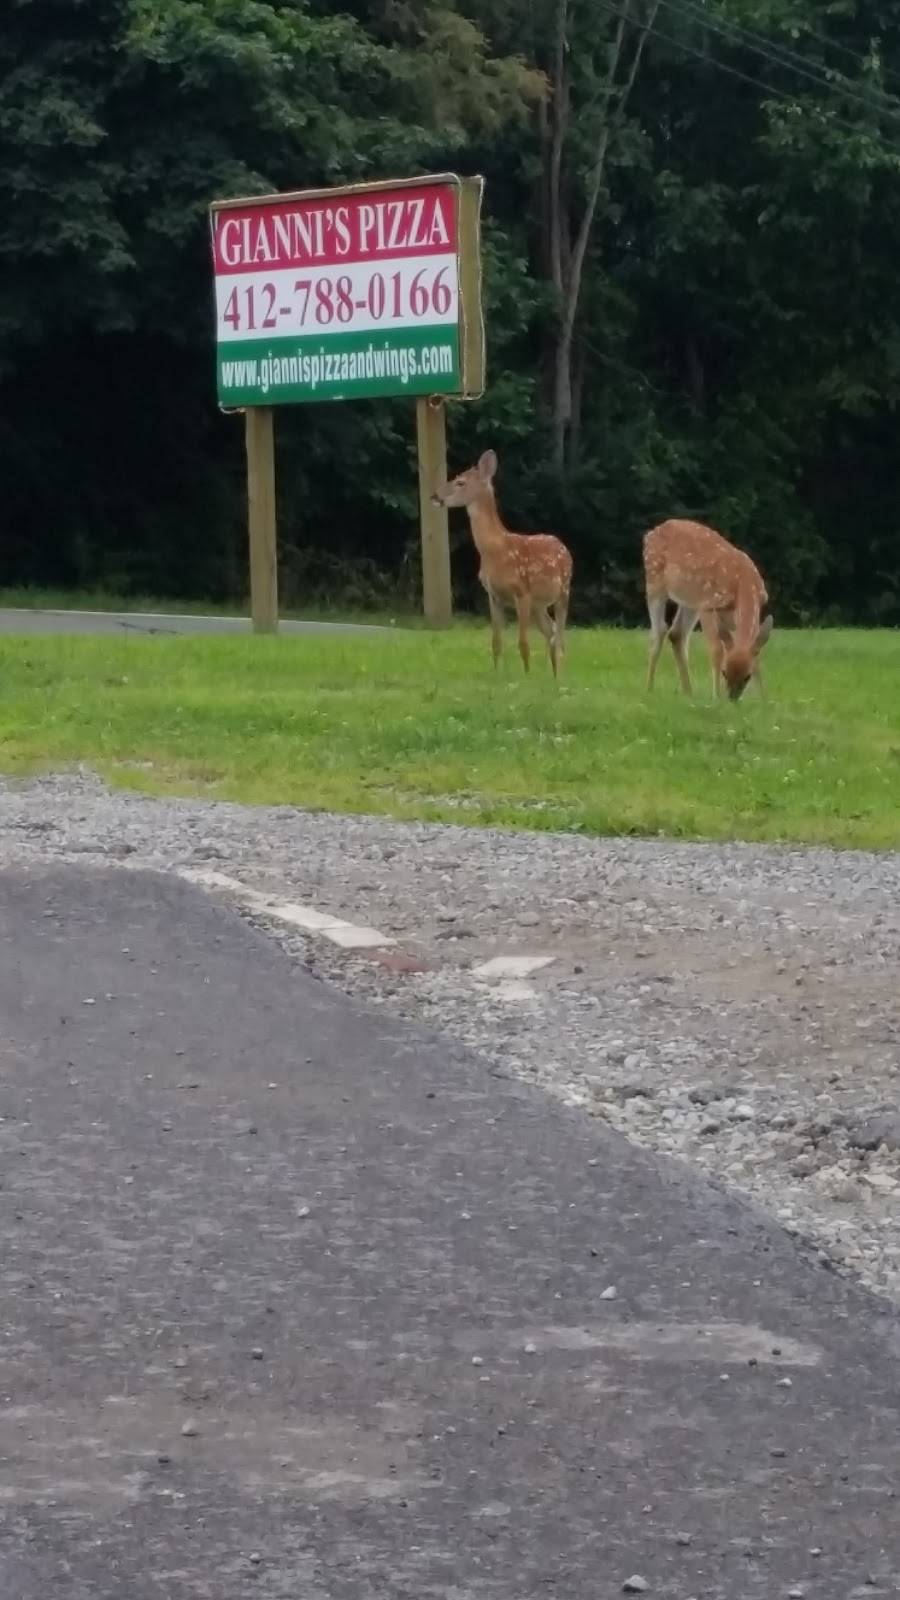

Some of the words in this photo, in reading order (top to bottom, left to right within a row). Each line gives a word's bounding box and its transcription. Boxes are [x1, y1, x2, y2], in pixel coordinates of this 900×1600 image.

[220, 206, 351, 266] GIANNI'S
[358, 198, 450, 252] PIZZA
[223, 266, 451, 331] 412-788-0166
[221, 342, 453, 393] www.giannispizzaandwings.com
